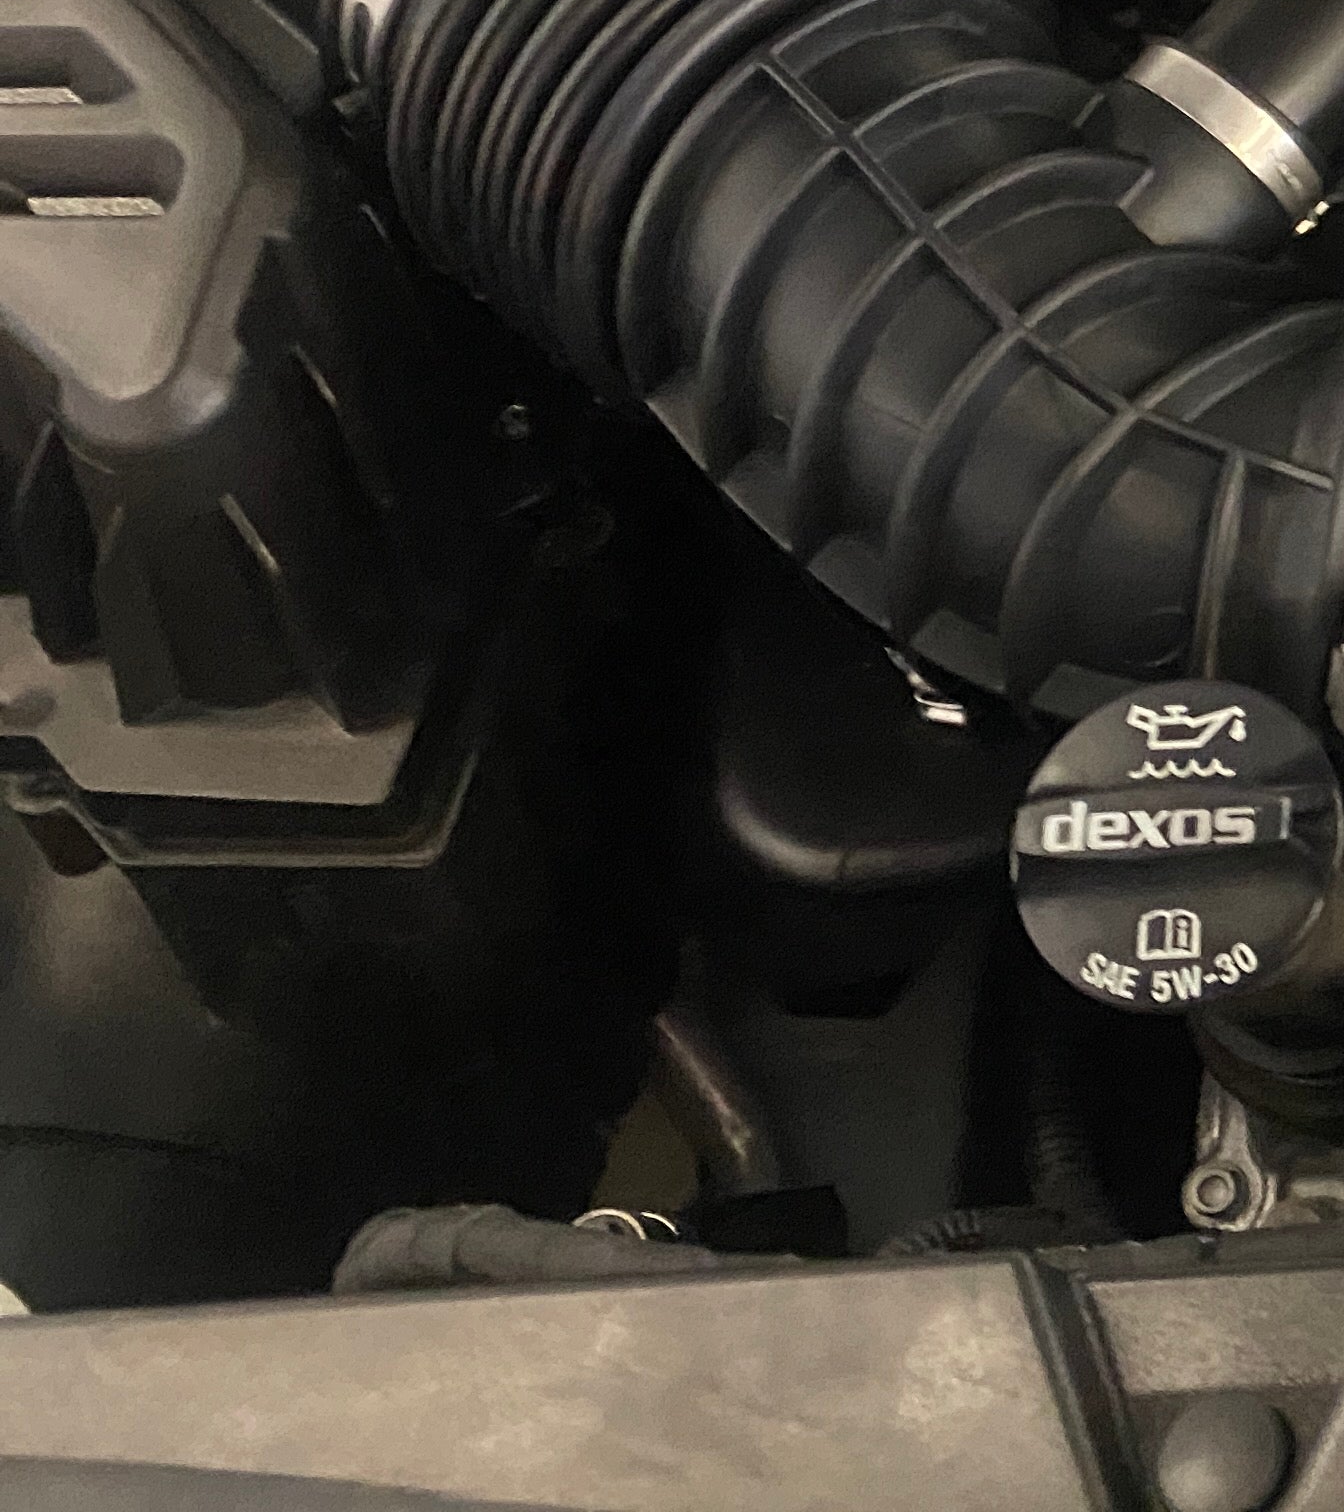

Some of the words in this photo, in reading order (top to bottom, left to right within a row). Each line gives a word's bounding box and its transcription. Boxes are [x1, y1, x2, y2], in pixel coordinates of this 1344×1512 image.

[1042, 799, 1257, 853] dexos
[1079, 951, 1141, 1000] SAE
[1150, 941, 1259, 1004] 5W-30
